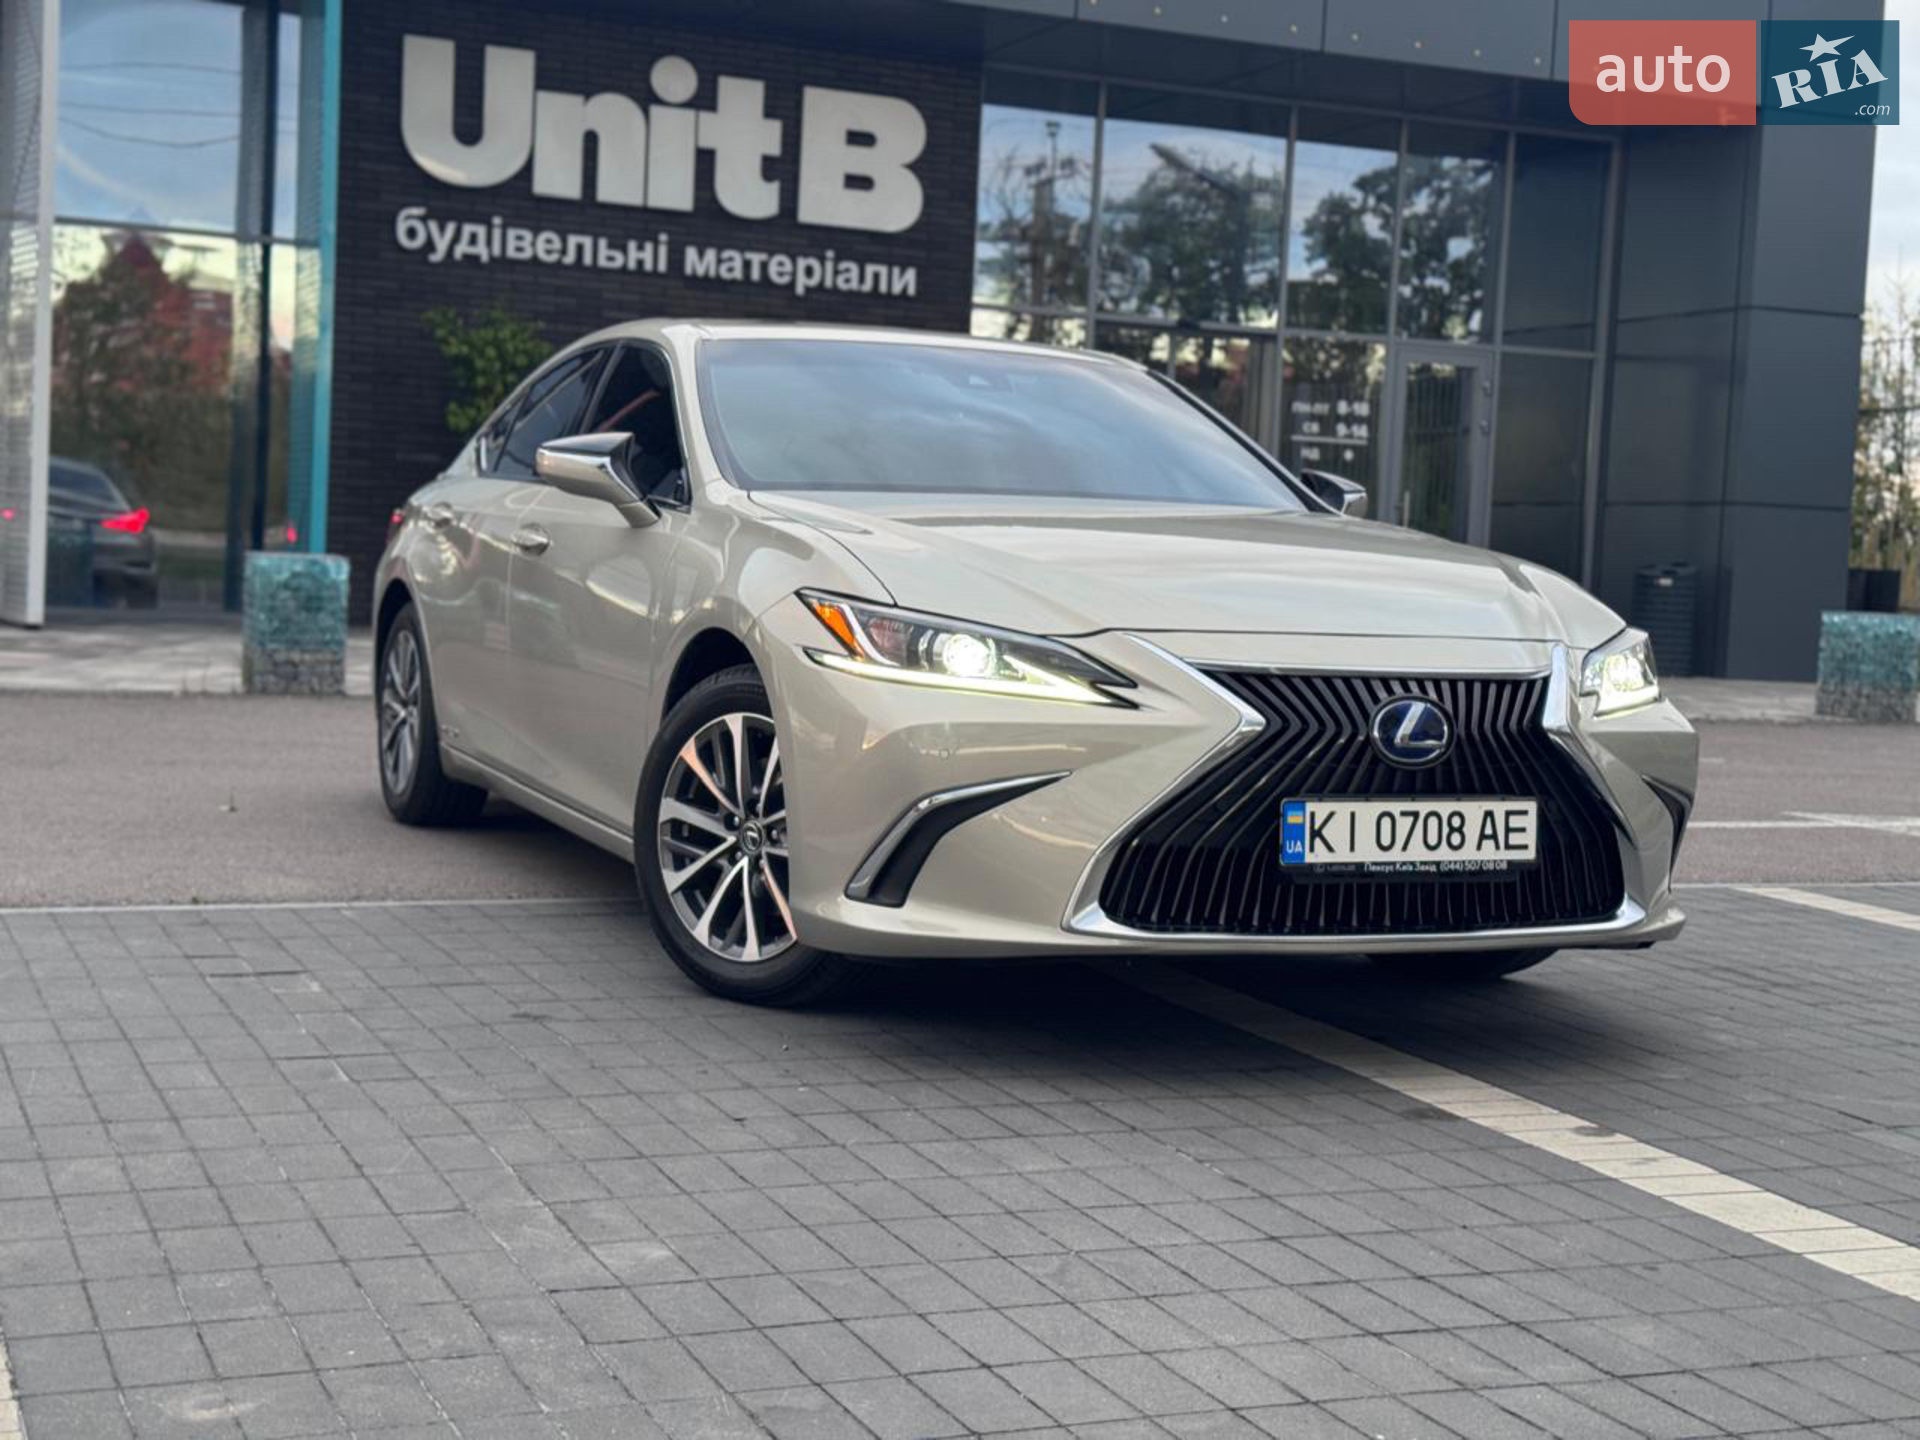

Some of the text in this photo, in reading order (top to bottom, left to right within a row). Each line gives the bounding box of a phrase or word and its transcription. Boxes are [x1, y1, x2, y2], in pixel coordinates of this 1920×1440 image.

[395, 206, 918, 297] будівельні матеріали
[1286, 840, 1303, 854] UA
[1375, 810, 1466, 852] 0708
[1475, 809, 1529, 851] AE
